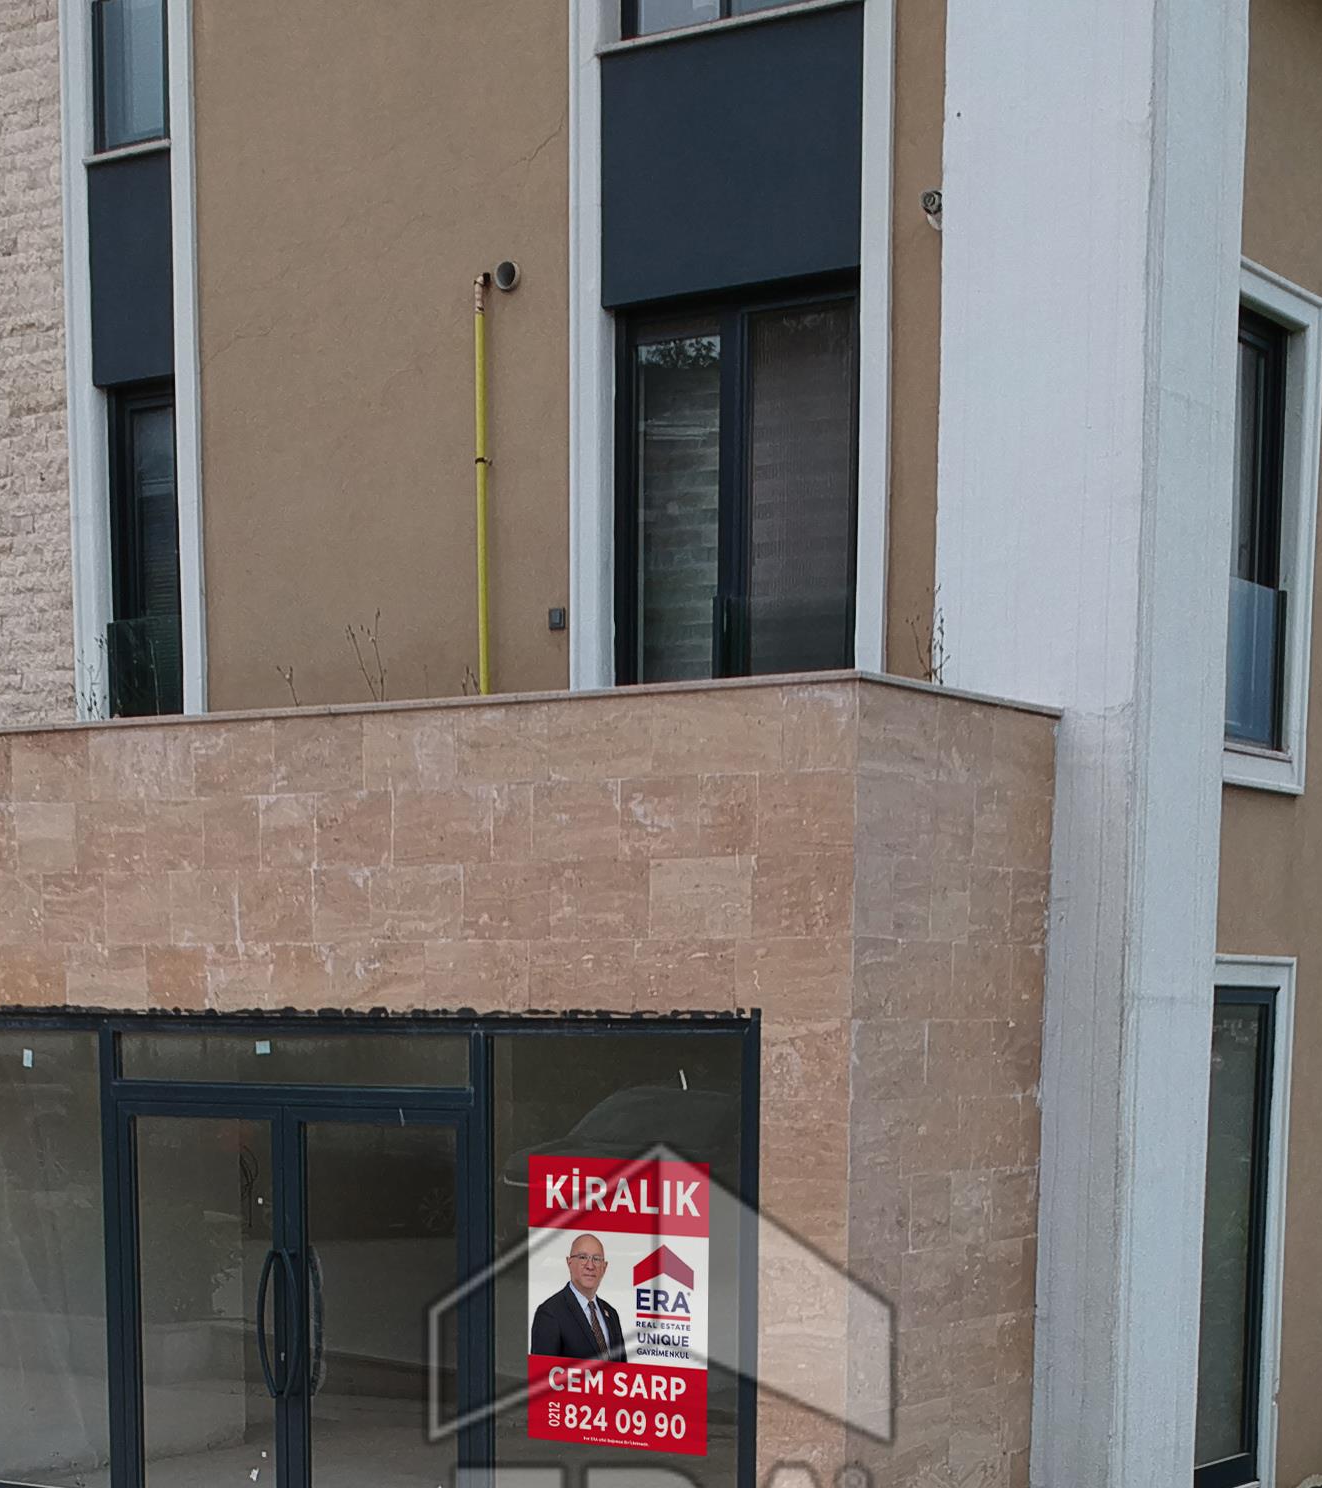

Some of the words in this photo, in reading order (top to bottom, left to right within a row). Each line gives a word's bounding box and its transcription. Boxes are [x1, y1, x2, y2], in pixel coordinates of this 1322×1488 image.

[546, 1168, 701, 1217] KİRALIK
[636, 1288, 691, 1314] ERA
[636, 1321, 658, 1329] REAL
[661, 1323, 691, 1332] ESTATE
[637, 1333, 689, 1347] UNIQUE
[637, 1347, 689, 1359] GAYRİMENKUL
[548, 1366, 603, 1395] CEM
[613, 1371, 687, 1402] SARP
[548, 1401, 561, 1427] 0212
[564, 1403, 608, 1432] 824
[615, 1408, 647, 1436] 09
[654, 1412, 686, 1439] 90
